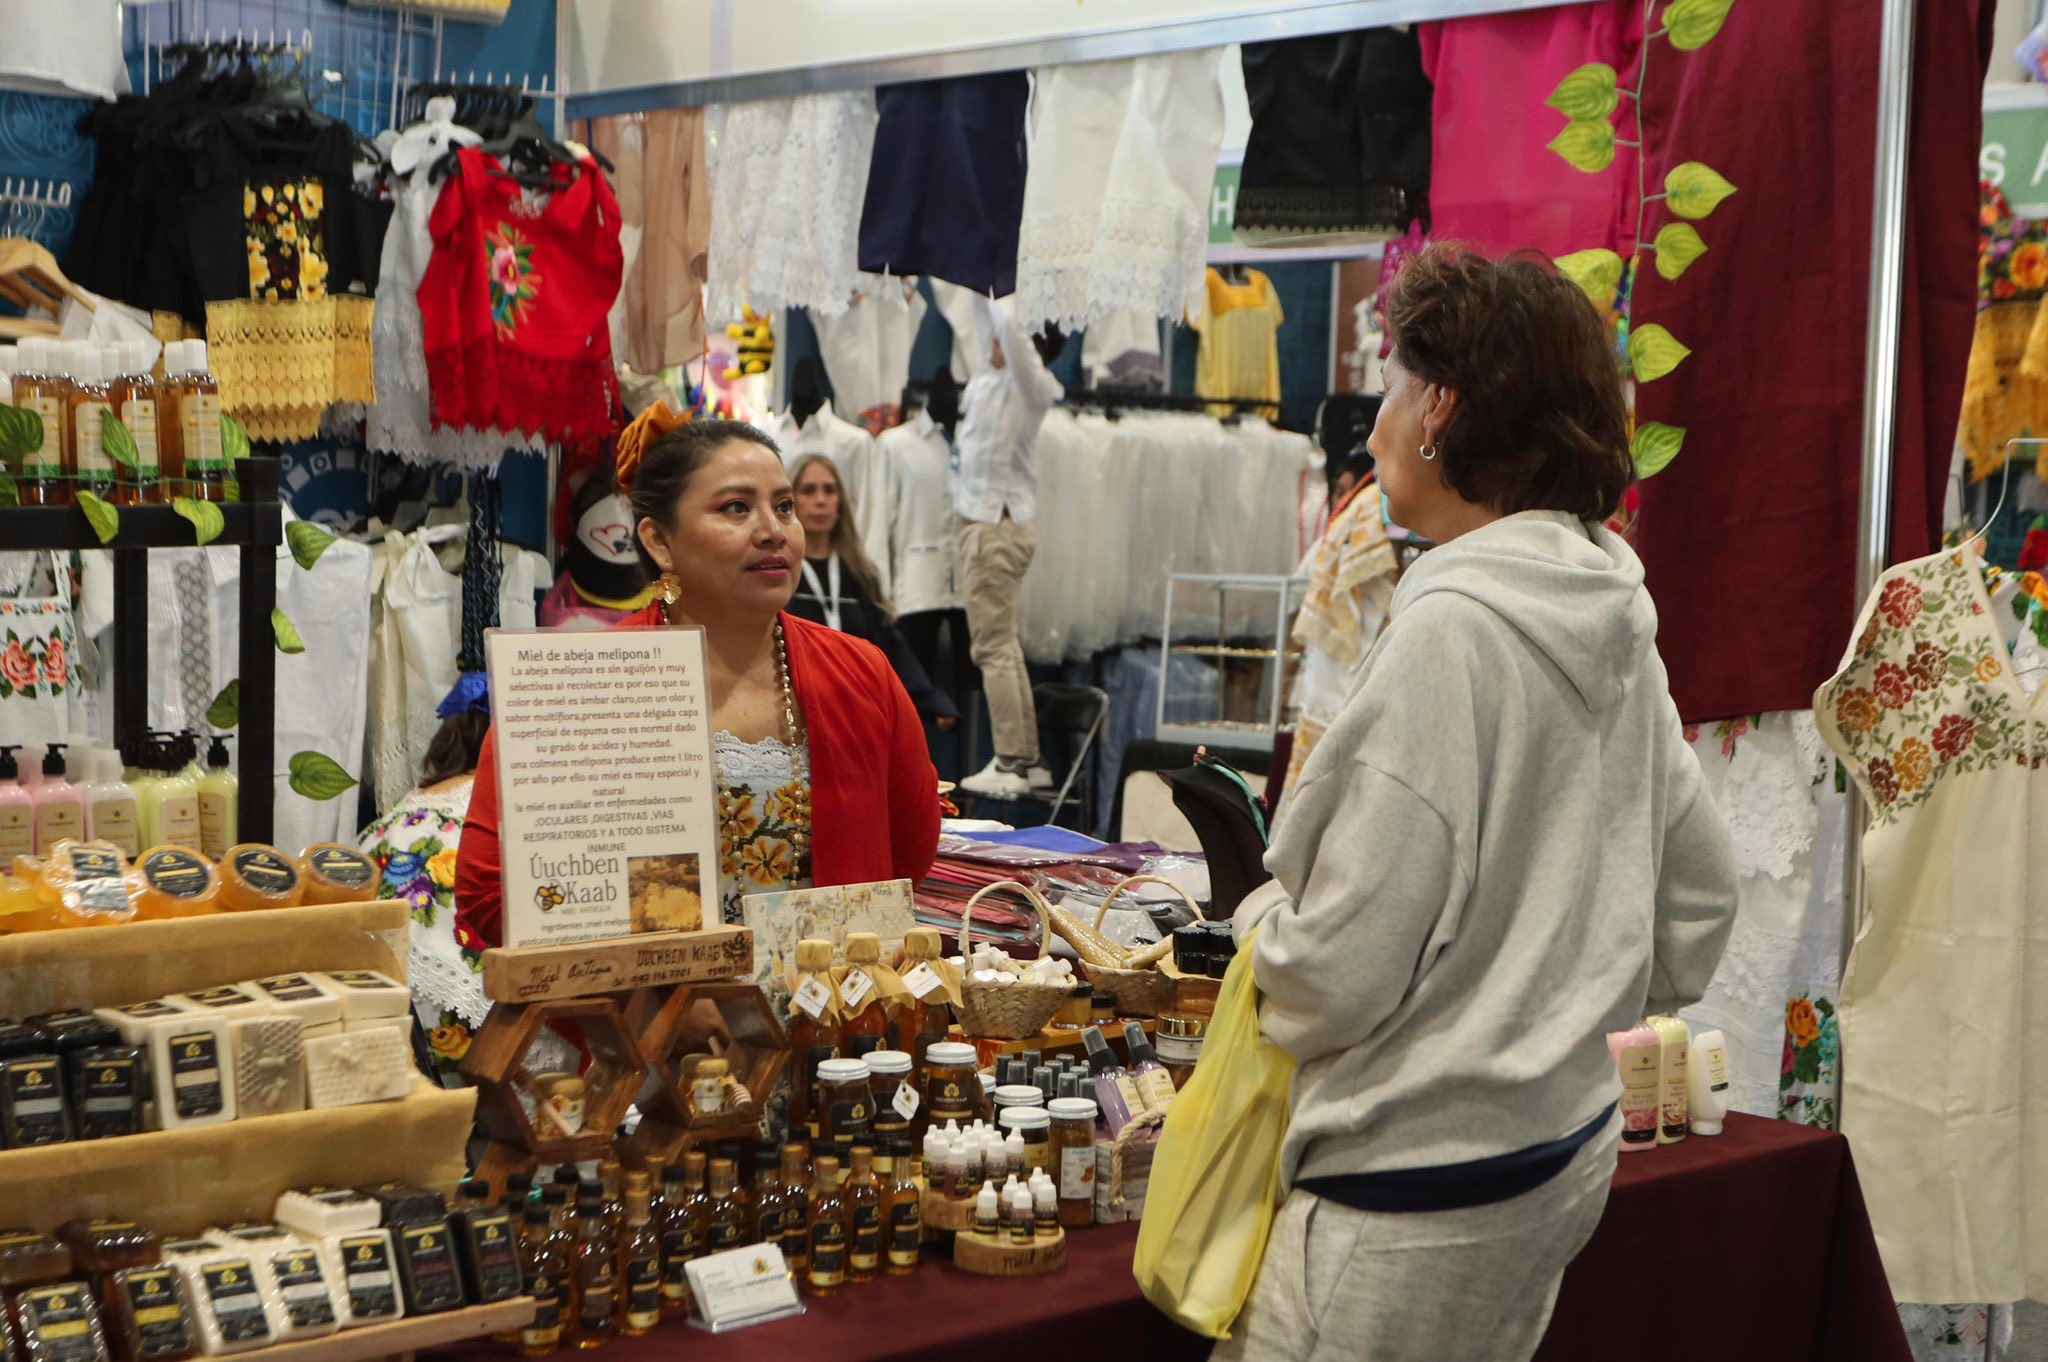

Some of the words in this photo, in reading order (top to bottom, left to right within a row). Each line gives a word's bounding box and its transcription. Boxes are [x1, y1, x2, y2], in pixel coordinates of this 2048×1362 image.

[1212, 185, 1234, 225] H
[518, 650, 543, 661] Miel
[547, 650, 560, 661] de
[564, 650, 594, 663] abeja
[598, 648, 650, 662] melipona
[512, 667, 522, 675] La
[525, 666, 548, 677] abeja
[552, 666, 592, 678] melipona
[608, 665, 621, 673] sin
[659, 665, 664, 674] y
[667, 665, 685, 674] muy
[510, 682, 553, 691] selectivas
[556, 681, 564, 690] al
[567, 680, 611, 690] recolectar
[627, 681, 641, 690] por
[662, 680, 676, 689] que
[680, 679, 689, 687] su
[507, 698, 529, 706] color
[533, 697, 543, 706] de
[546, 696, 565, 705] miel
[669, 693, 687, 702] olor
[689, 695, 694, 704] y
[505, 714, 531, 722] sabor
[643, 710, 676, 720] delgada
[679, 709, 698, 718] capa
[510, 728, 557, 739] superficial
[560, 727, 571, 736] de
[573, 727, 608, 737] espuma
[641, 724, 672, 733] normal
[550, 743, 575, 754] grado
[579, 741, 589, 751] de
[592, 741, 618, 750] acidez
[622, 742, 627, 750] y
[530, 759, 568, 768] colmena
[571, 757, 612, 768] melipona
[615, 754, 650, 765] produce
[653, 754, 676, 762] entre
[684, 753, 702, 761] litro
[514, 777, 529, 786] por
[532, 774, 549, 784] año
[552, 774, 567, 785] por
[570, 773, 585, 782] ello
[601, 771, 620, 780] miel
[635, 770, 655, 780] muy
[657, 768, 691, 778] especial
[694, 769, 699, 778] y
[592, 786, 625, 796] natural
[515, 804, 523, 812] la
[526, 802, 545, 812] miel
[560, 800, 591, 810] auxiliar
[595, 800, 604, 808] en
[607, 796, 666, 809] enfermedades
[669, 795, 692, 803] como
[524, 829, 597, 842] RESPIRATORIOS
[600, 828, 605, 837] Y
[609, 827, 614, 836] A
[618, 825, 642, 836] TODO
[646, 825, 685, 834] SISTEMA
[587, 843, 626, 853] INMUNE
[530, 852, 619, 879] Úuchben
[566, 879, 617, 904] Kaab
